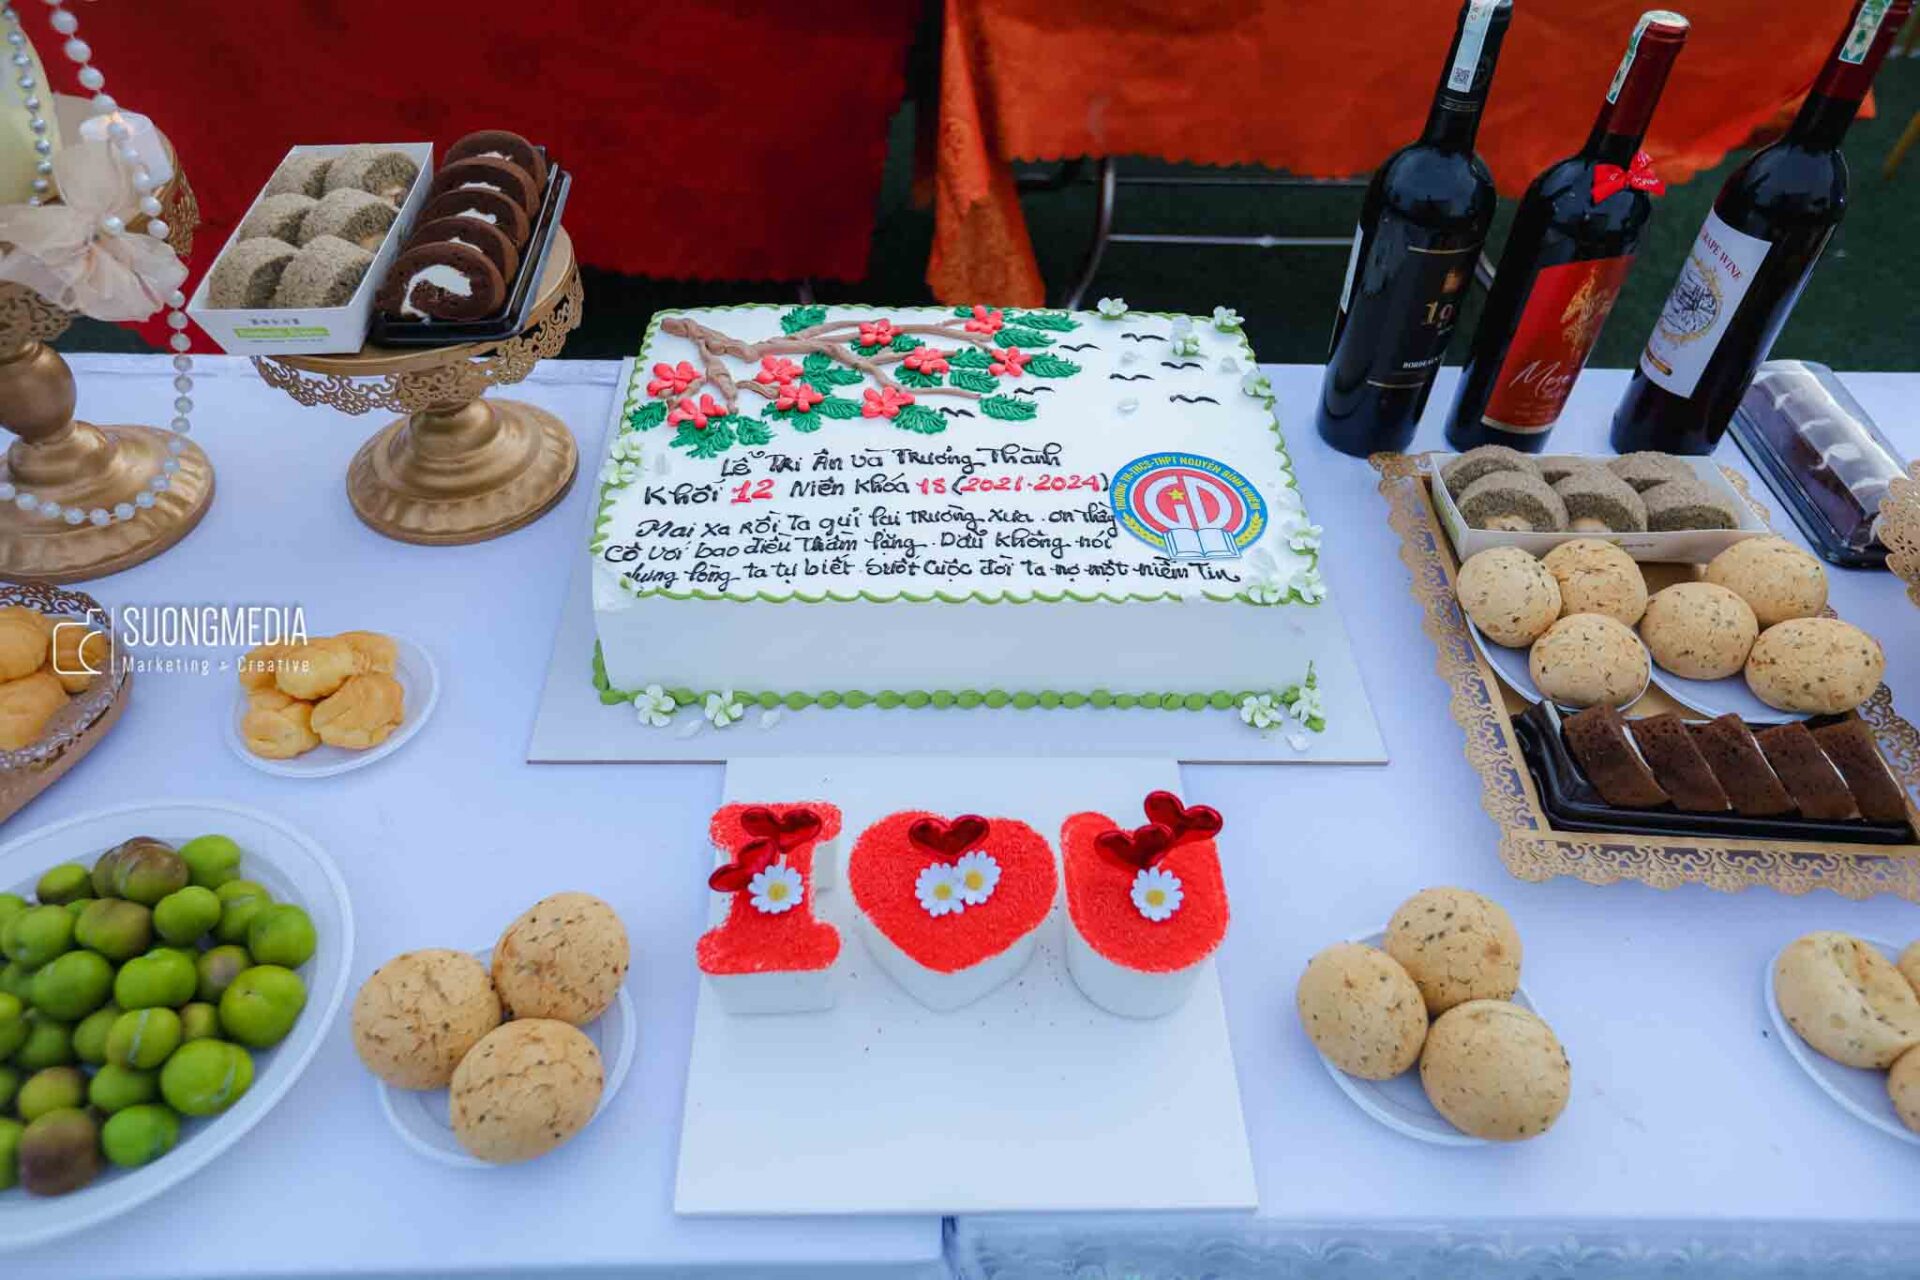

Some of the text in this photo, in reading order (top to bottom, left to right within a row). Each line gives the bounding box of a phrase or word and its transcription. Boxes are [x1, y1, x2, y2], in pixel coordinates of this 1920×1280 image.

[976, 442, 1062, 466] Thành
[645, 479, 725, 505] Khối
[731, 479, 775, 505] 12
[790, 476, 844, 497] Niên
[915, 477, 946, 495] 18
[635, 519, 697, 538] Mai
[694, 542, 740, 559] bao
[1075, 530, 1112, 549] nói
[1084, 559, 1129, 582] một
